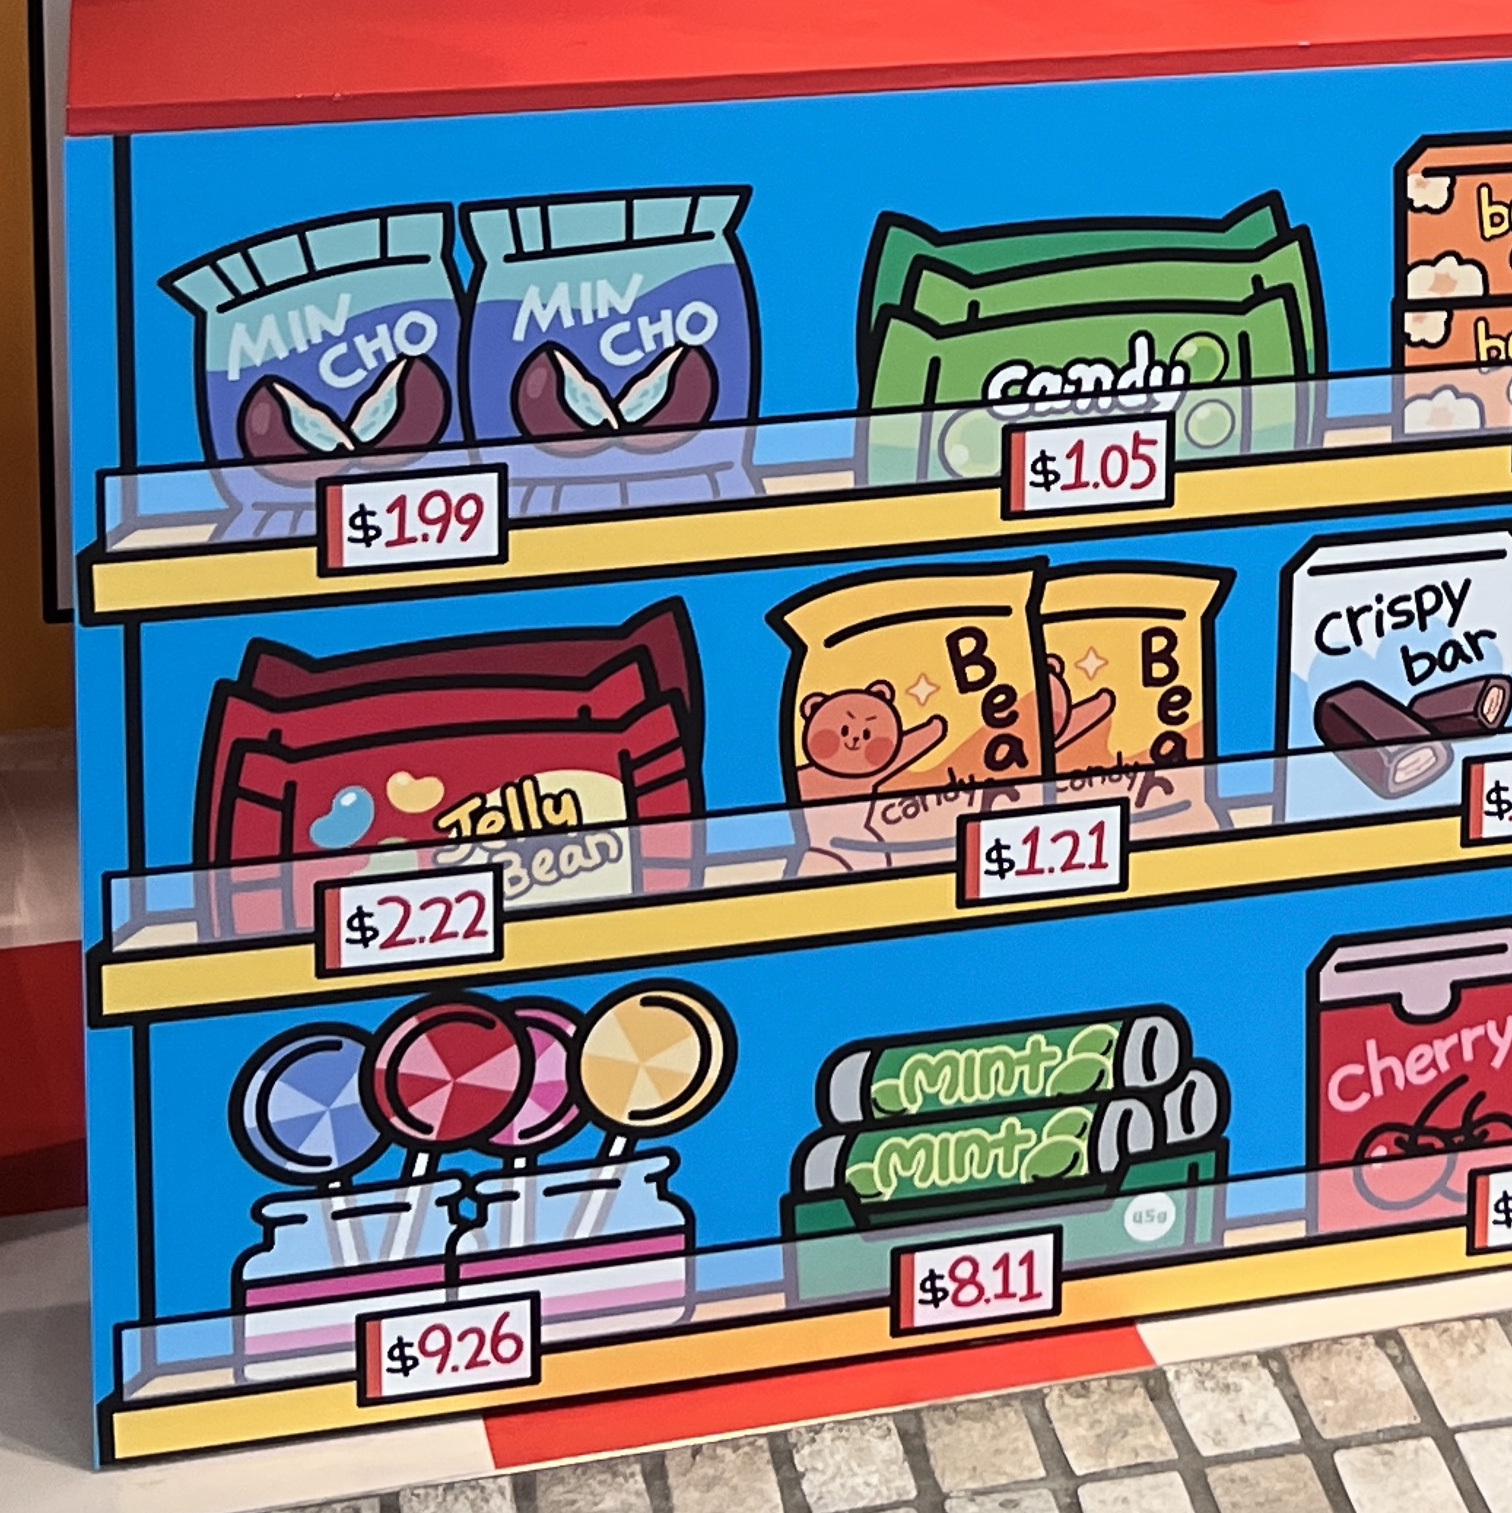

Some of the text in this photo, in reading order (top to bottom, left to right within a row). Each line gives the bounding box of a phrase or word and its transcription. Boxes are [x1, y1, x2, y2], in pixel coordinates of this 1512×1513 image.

[227, 293, 351, 380] MIN
[513, 273, 642, 340] MIN
[600, 301, 718, 365] CHO
[319, 311, 437, 388] CHO
[1030, 430, 1158, 491] $1.05
[347, 489, 484, 547] $1.99
[1315, 577, 1472, 656] crispy
[1400, 627, 1497, 686] bar
[985, 820, 1109, 878] $1.21
[346, 890, 488, 949] $2.22
[918, 1249, 1042, 1308] $8.11
[386, 1311, 524, 1376] $9.26
